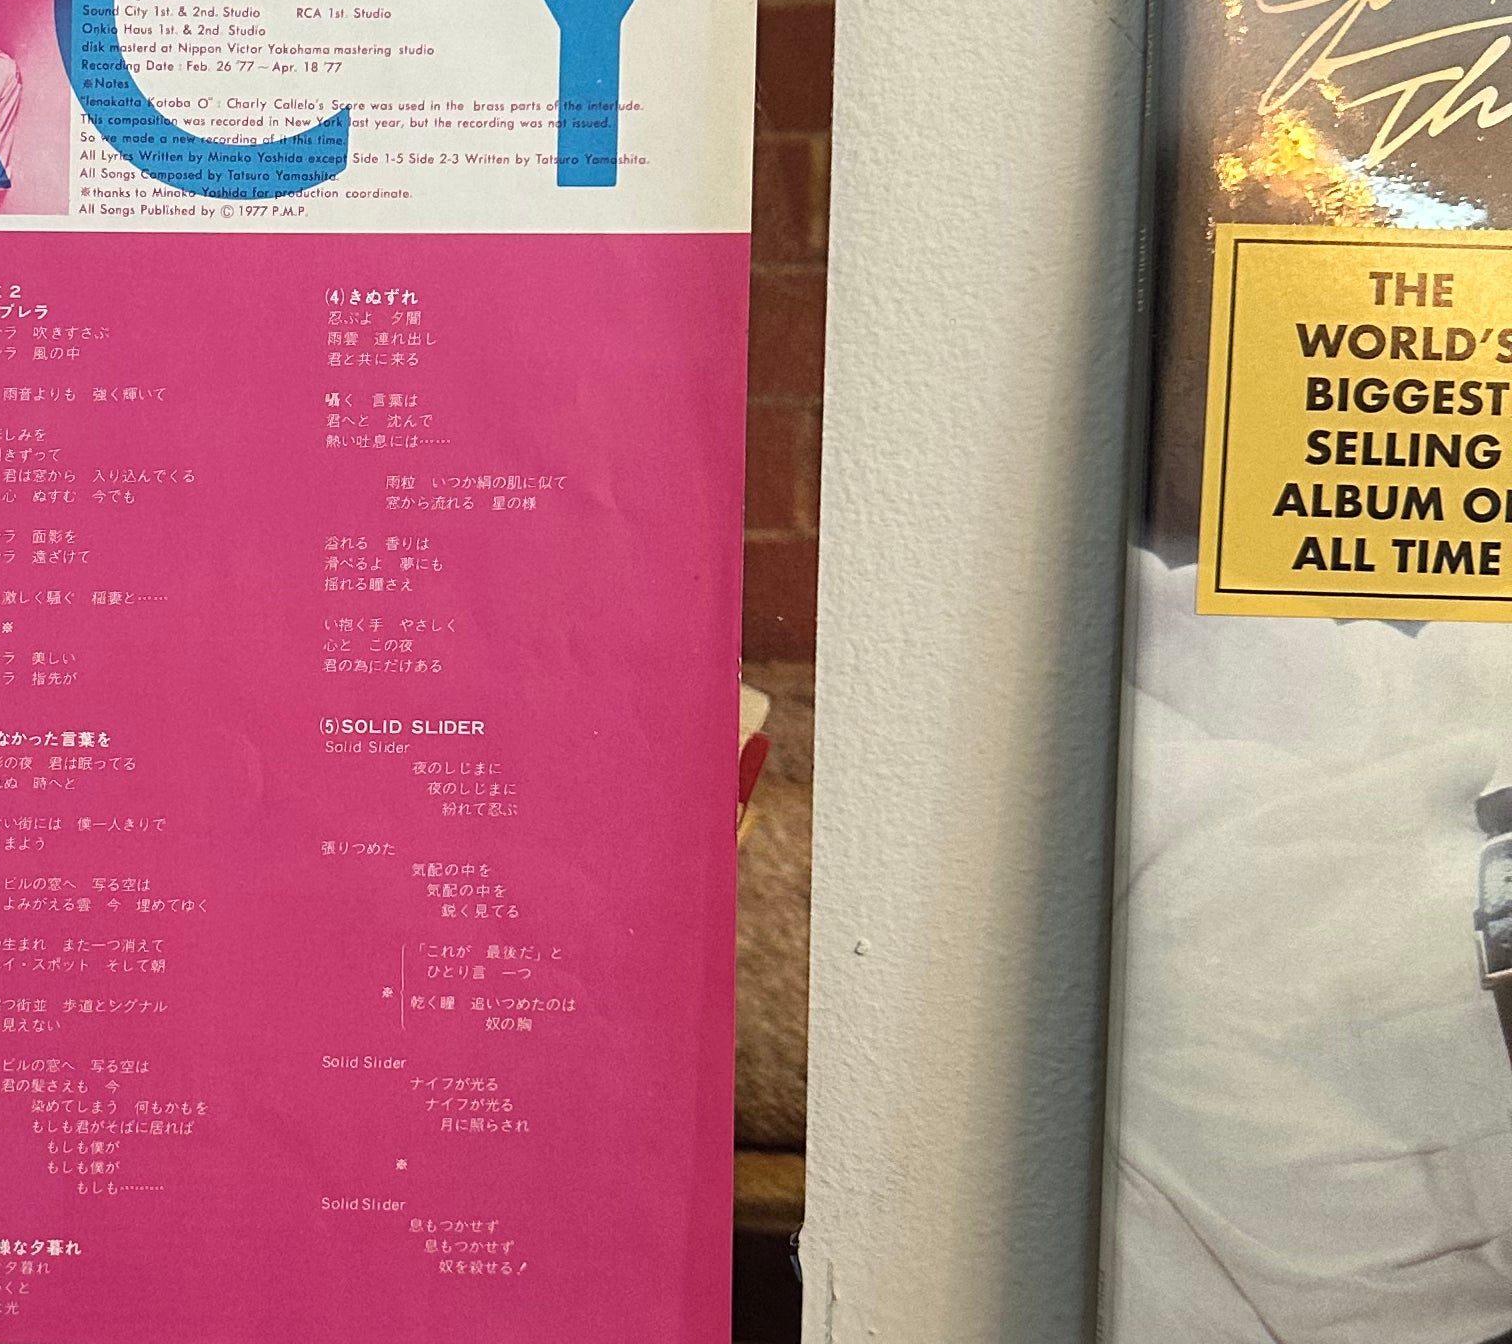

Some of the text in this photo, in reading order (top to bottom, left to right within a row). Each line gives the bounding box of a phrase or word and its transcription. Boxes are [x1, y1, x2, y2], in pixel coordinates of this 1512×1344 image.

[83, 6, 118, 17] Sound
[124, 6, 148, 19] City
[178, 7, 186, 17] &
[223, 7, 260, 18] Studio
[297, 8, 321, 19] RCA
[353, 8, 391, 19] Studio
[79, 205, 96, 215] All
[100, 205, 135, 217] Songs
[141, 206, 195, 217] Published
[201, 206, 215, 218] by
[239, 206, 267, 217] 1977
[10, 285, 21, 298] 2
[1369, 271, 1455, 307] THE
[1305, 377, 1510, 416] BIGGEST
[1305, 429, 1502, 469] SELLING
[1272, 483, 1444, 521] ALBUM
[1292, 537, 1500, 576] ALL TIME
[412, 720, 484, 735] SLIDER
[326, 741, 410, 753] Solid Slider
[322, 1056, 406, 1069] Solid Slider
[322, 1197, 406, 1211] Solid Slider
